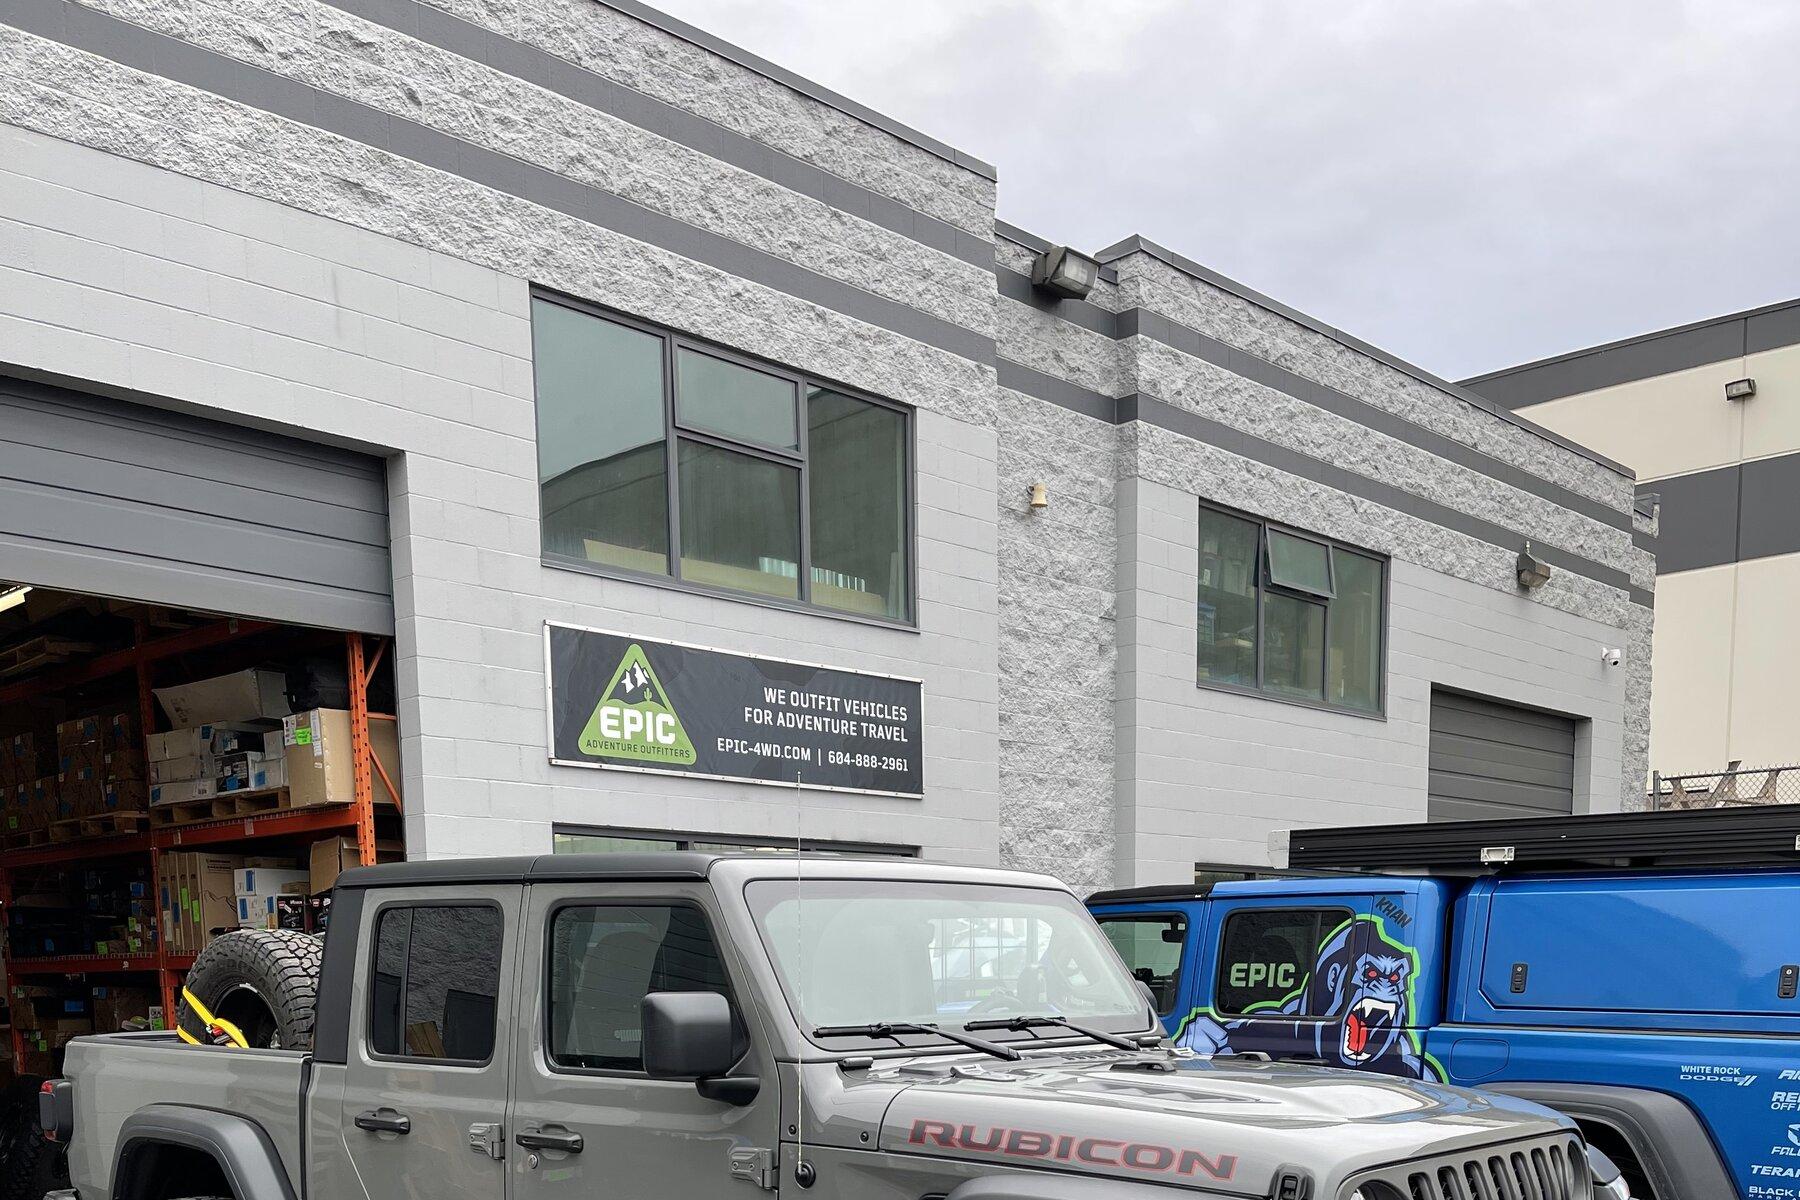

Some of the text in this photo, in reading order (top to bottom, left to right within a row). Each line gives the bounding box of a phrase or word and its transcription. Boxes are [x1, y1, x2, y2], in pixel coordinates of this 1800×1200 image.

[764, 687, 908, 722] WE OUTFIT VEHICLES
[599, 705, 676, 745] EPIC
[744, 707, 908, 743] FOR ADVENTURE TRAVEL
[586, 740, 690, 758] ADVENTURE OUTFITTERS
[717, 738, 811, 761] EPIC-4WD.COM
[828, 750, 909, 772] 604-888-2961
[1375, 897, 1412, 929] KHAN
[1229, 963, 1296, 988] EPIC
[1681, 1065, 1741, 1075] WHITE ROCK
[1770, 1102, 1797, 1111] OFF
[908, 1119, 1239, 1181] RUBICON
[1749, 1185, 1794, 1197] BLACK
